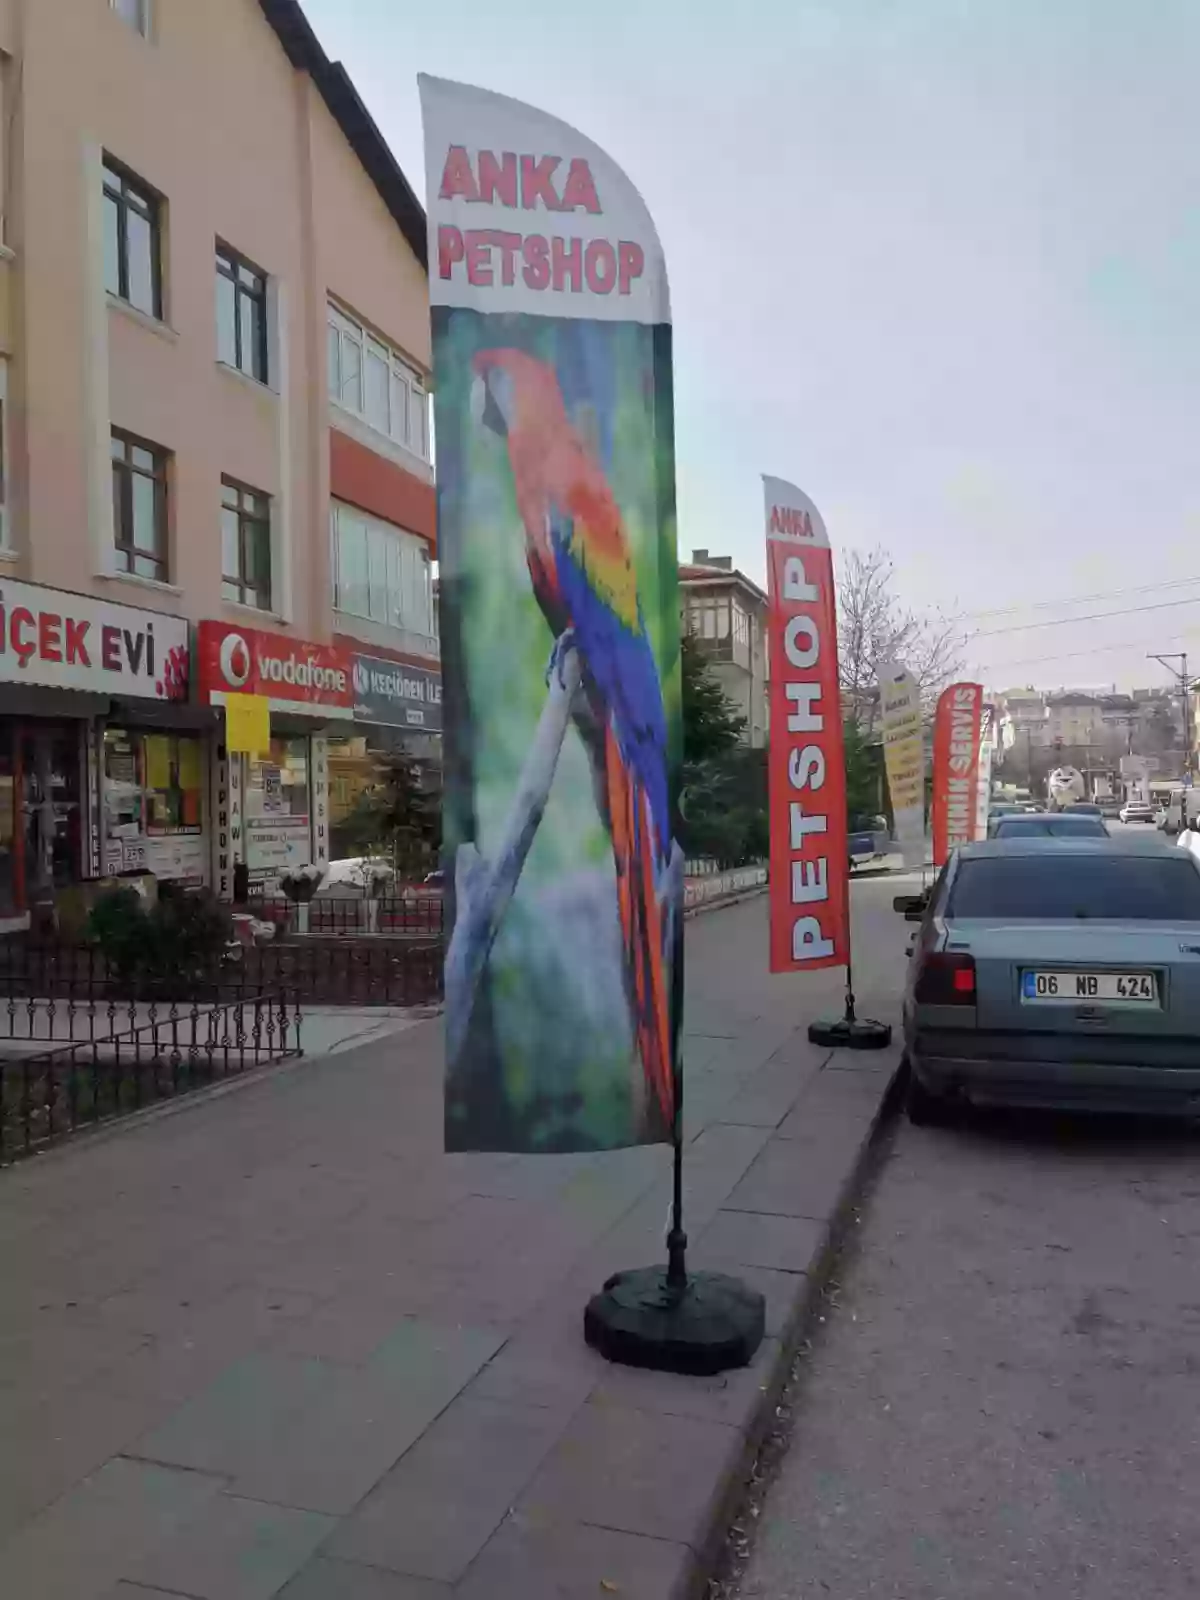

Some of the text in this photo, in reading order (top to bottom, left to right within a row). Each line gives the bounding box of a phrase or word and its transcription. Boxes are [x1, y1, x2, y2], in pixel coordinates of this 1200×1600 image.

[438, 143, 603, 214] ANKA
[437, 223, 645, 295] PETSHOP
[769, 504, 814, 538] ANKA
[102, 622, 155, 676] EVİ
[257, 653, 346, 692] vodafone
[784, 556, 835, 961] PETSHOP
[1037, 975, 1150, 997] 06 NB 424
